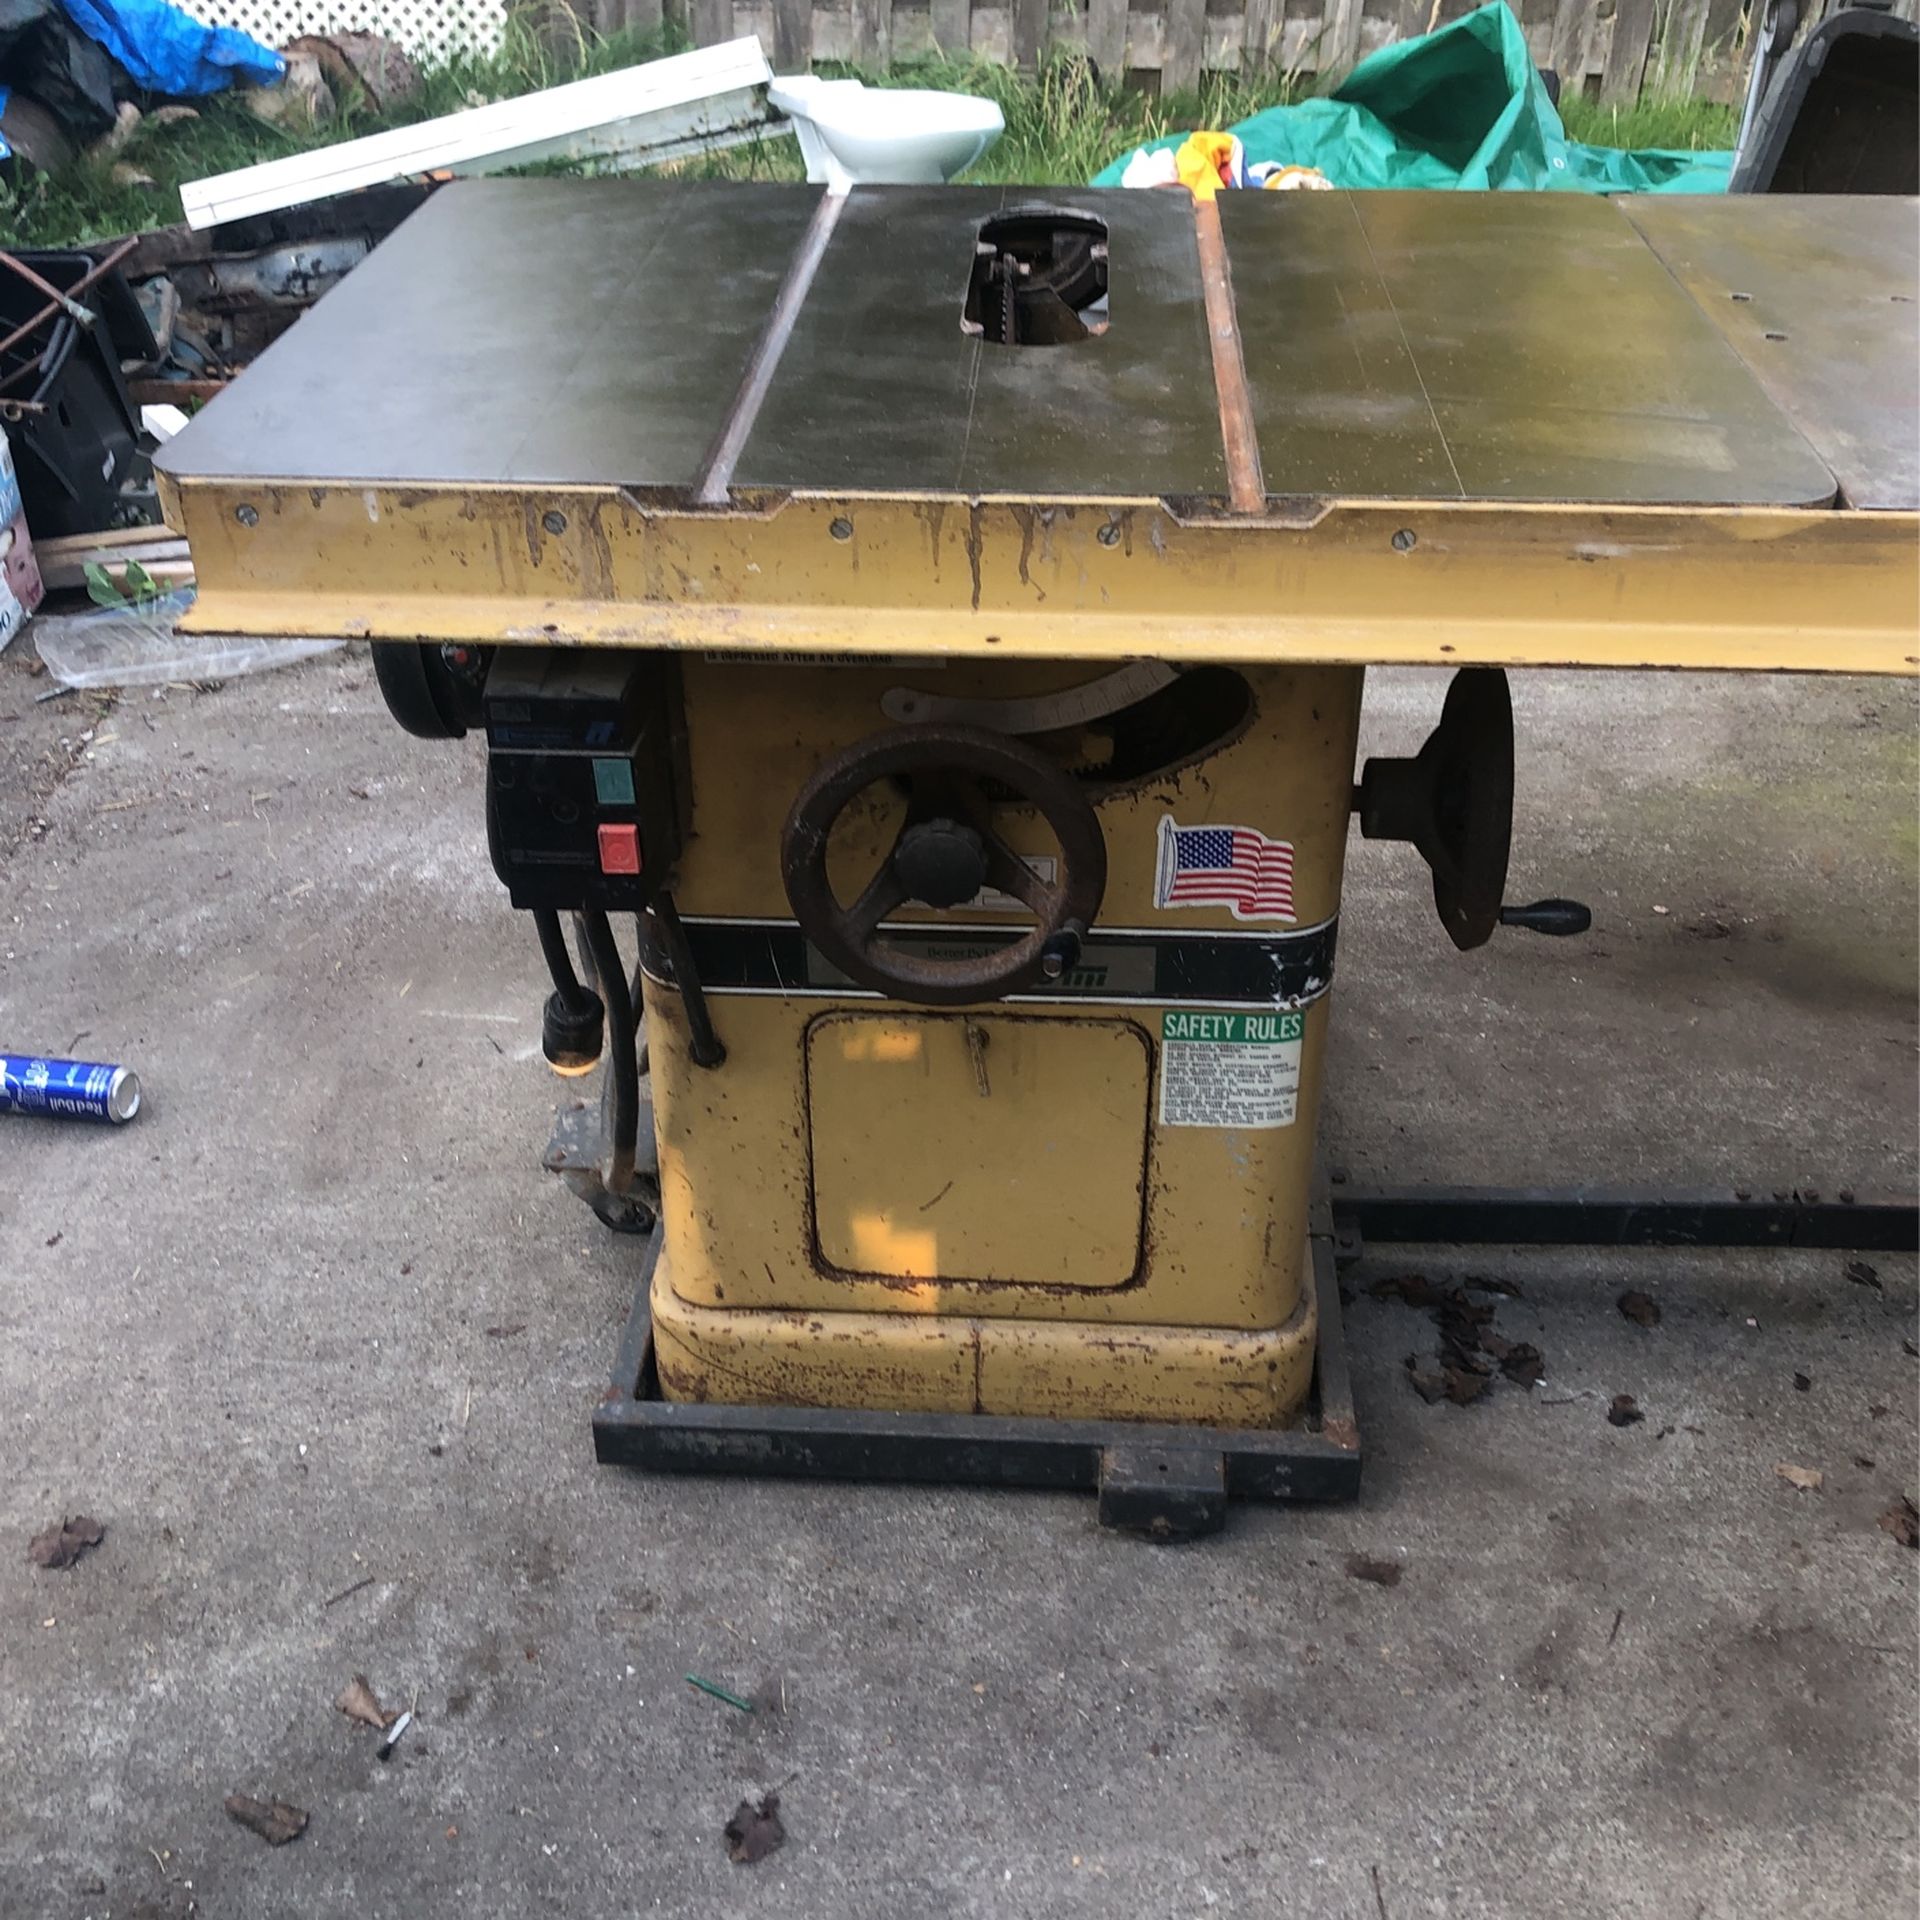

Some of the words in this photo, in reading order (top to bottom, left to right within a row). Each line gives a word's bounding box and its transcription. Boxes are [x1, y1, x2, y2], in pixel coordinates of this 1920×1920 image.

[783, 652, 815, 662] AFTER
[819, 653, 833, 662] AN
[1164, 1014, 1235, 1039] SAFETY
[1244, 1013, 1302, 1040] RULES
